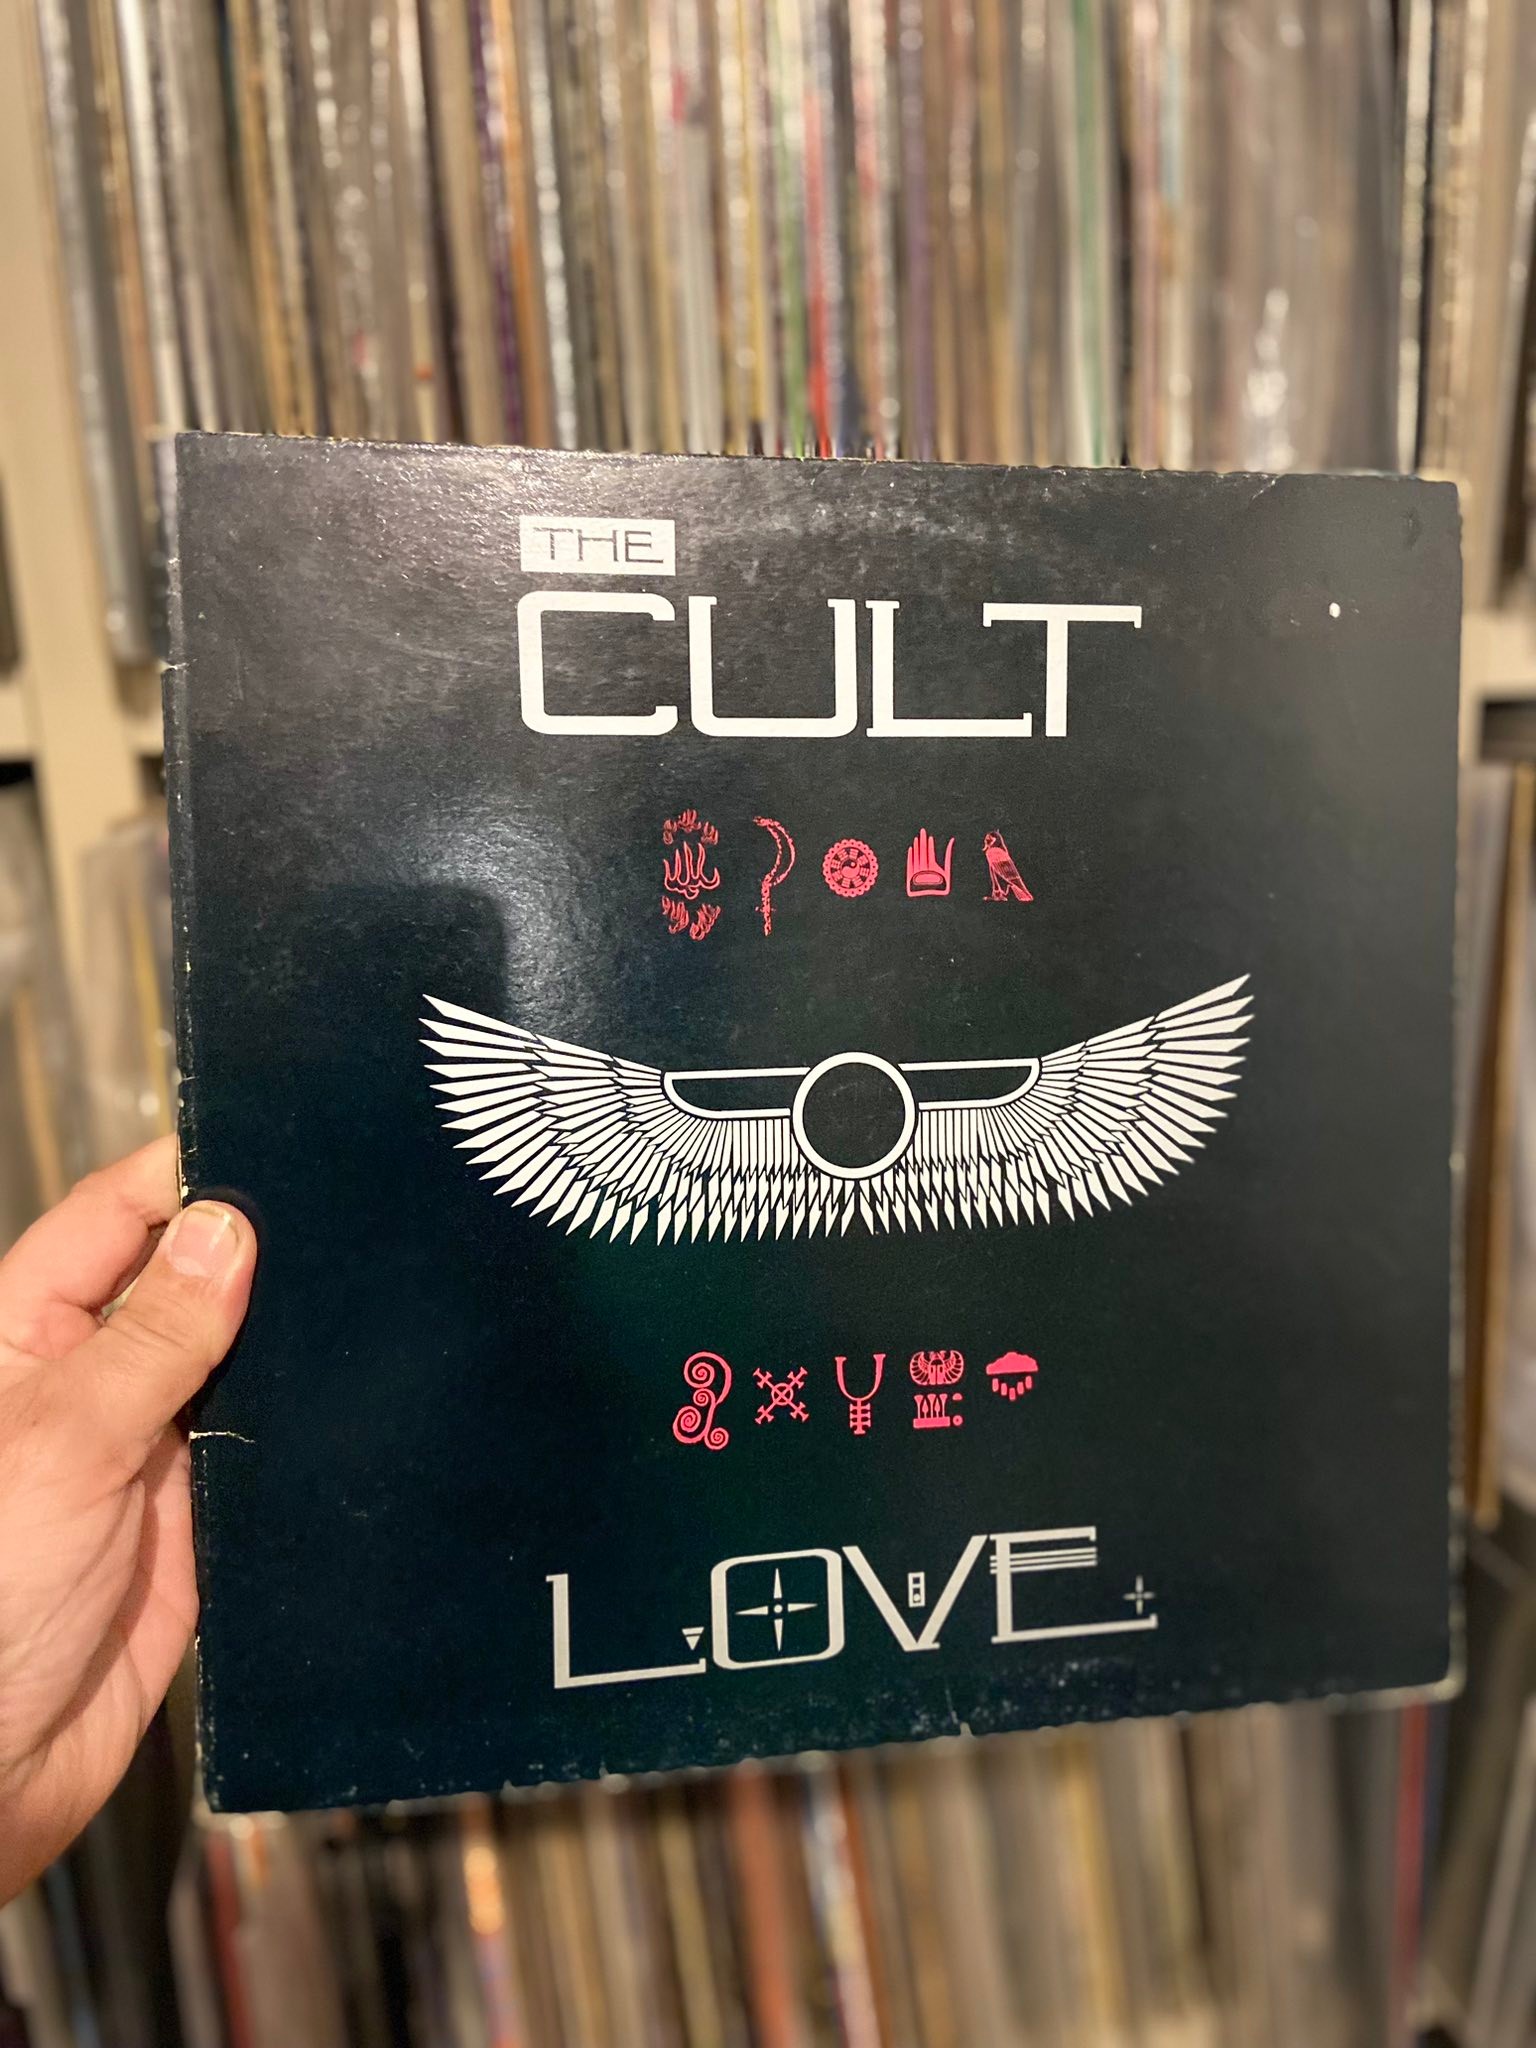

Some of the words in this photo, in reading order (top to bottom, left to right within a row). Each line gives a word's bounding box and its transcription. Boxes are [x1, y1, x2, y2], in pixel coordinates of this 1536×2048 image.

[531, 525, 666, 565] THE
[516, 590, 1143, 738] CULT
[546, 1526, 1158, 1690] LOVE
